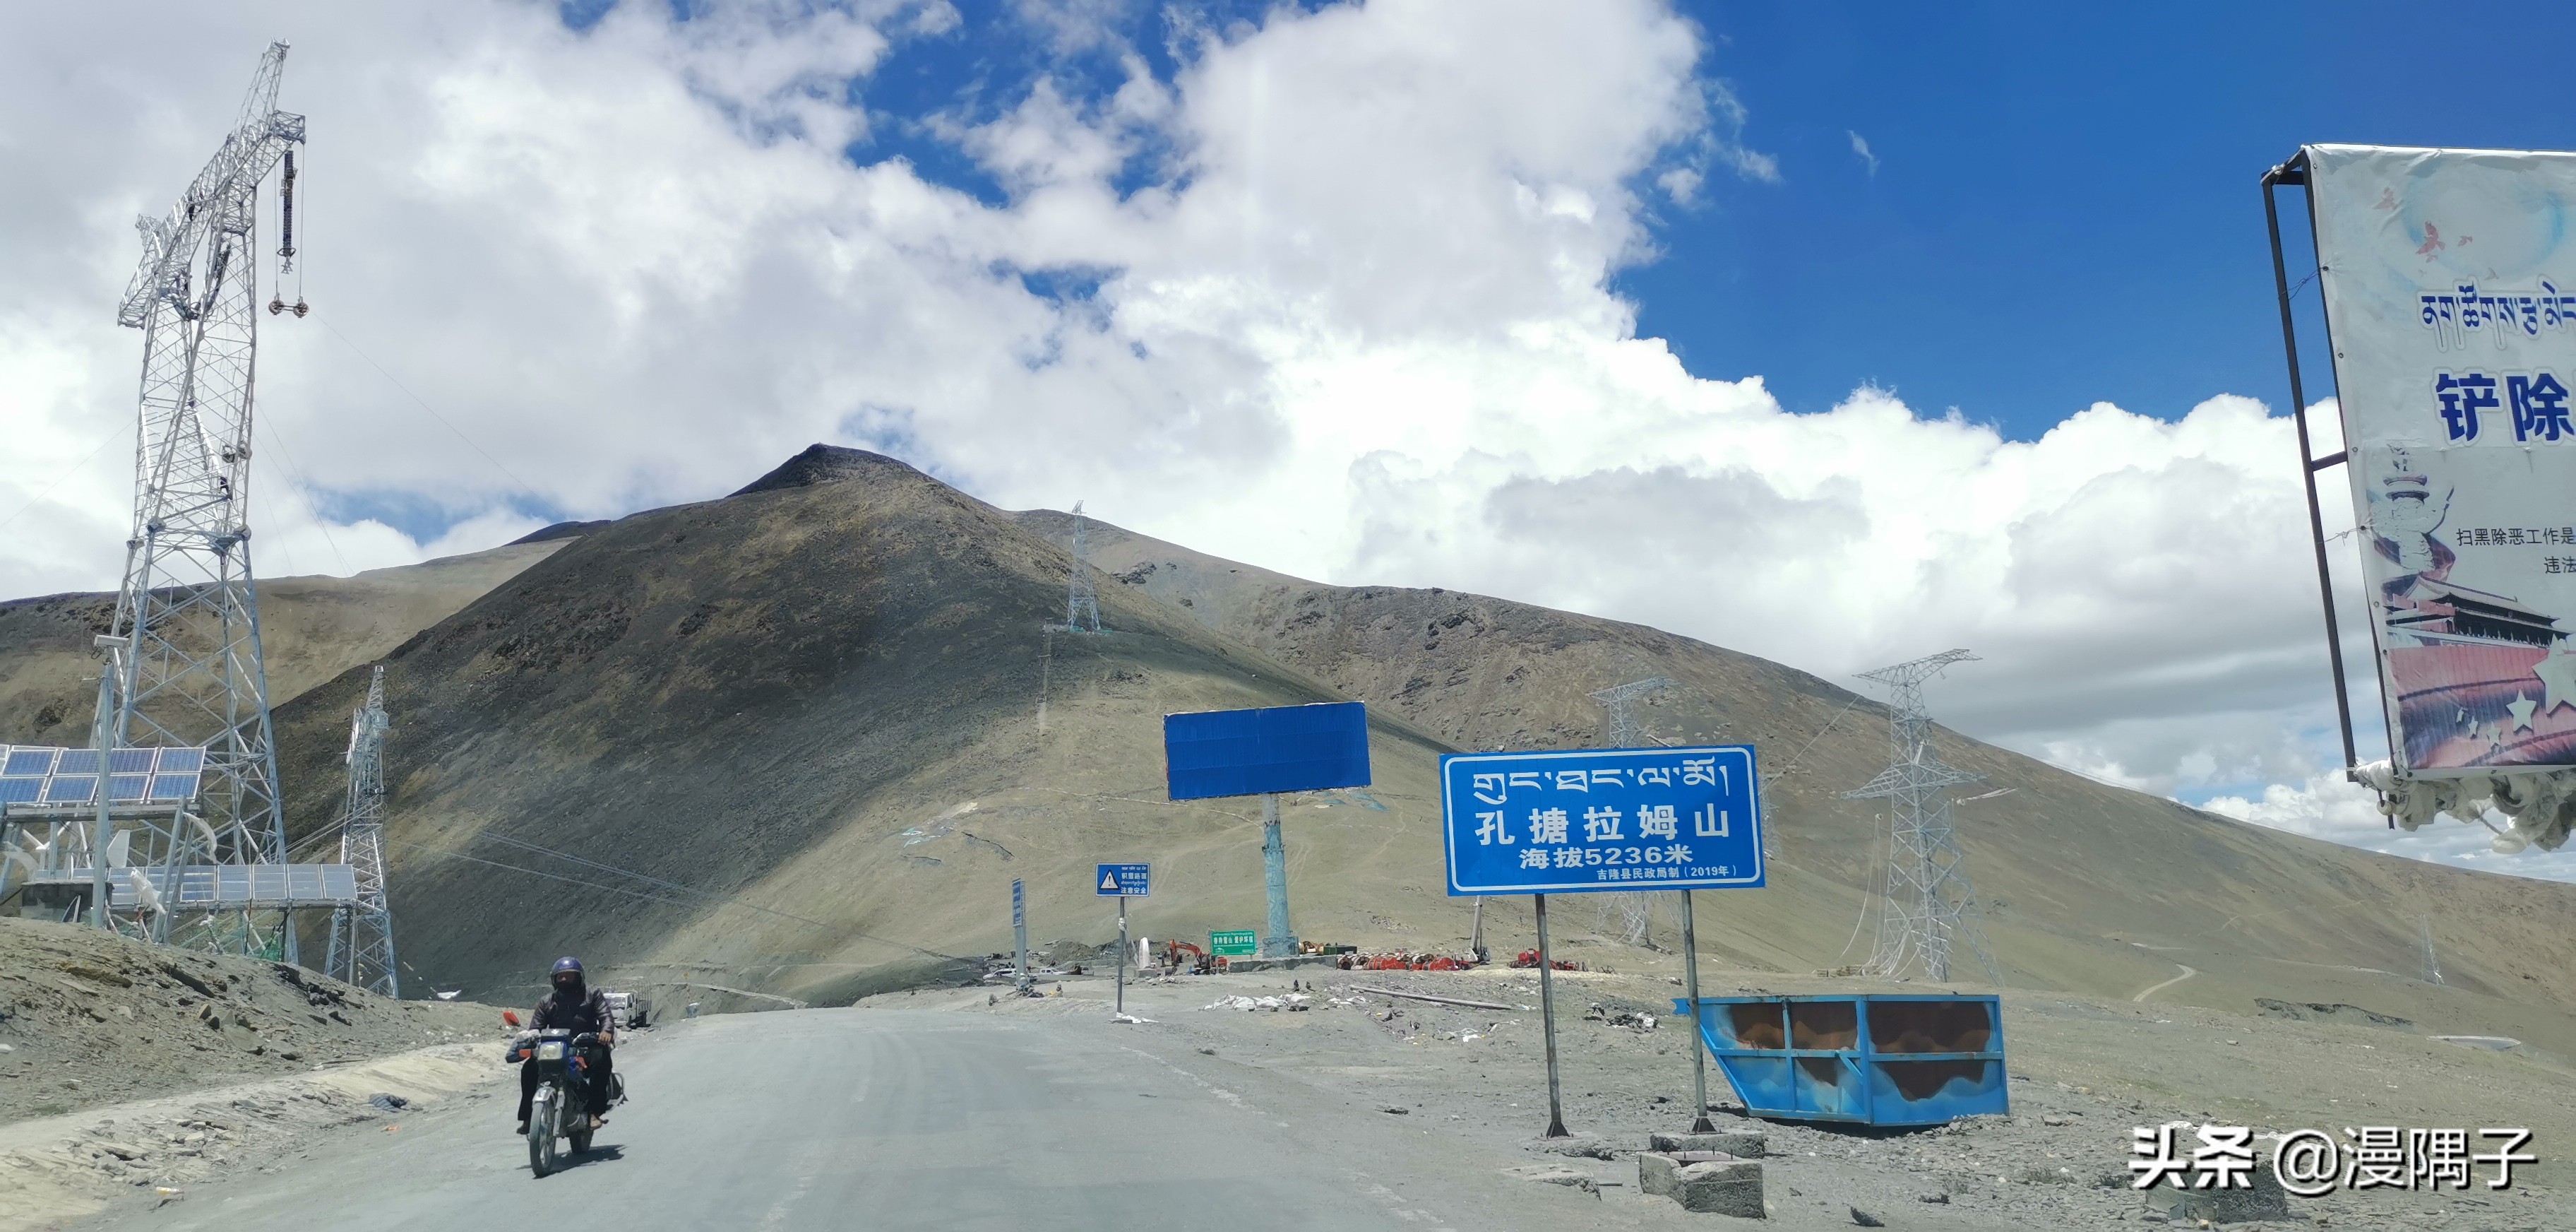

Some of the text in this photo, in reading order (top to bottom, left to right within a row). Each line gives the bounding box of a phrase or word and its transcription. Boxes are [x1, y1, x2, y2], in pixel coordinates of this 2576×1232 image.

[2435, 373, 2575, 442] 铲除
[2456, 527, 2576, 546] 扫黑除恶工作是
[2544, 556, 2576, 574] 违法
[1474, 802, 1729, 846] 孔搪拉姆山
[1519, 843, 1693, 870] 海拔5236米
